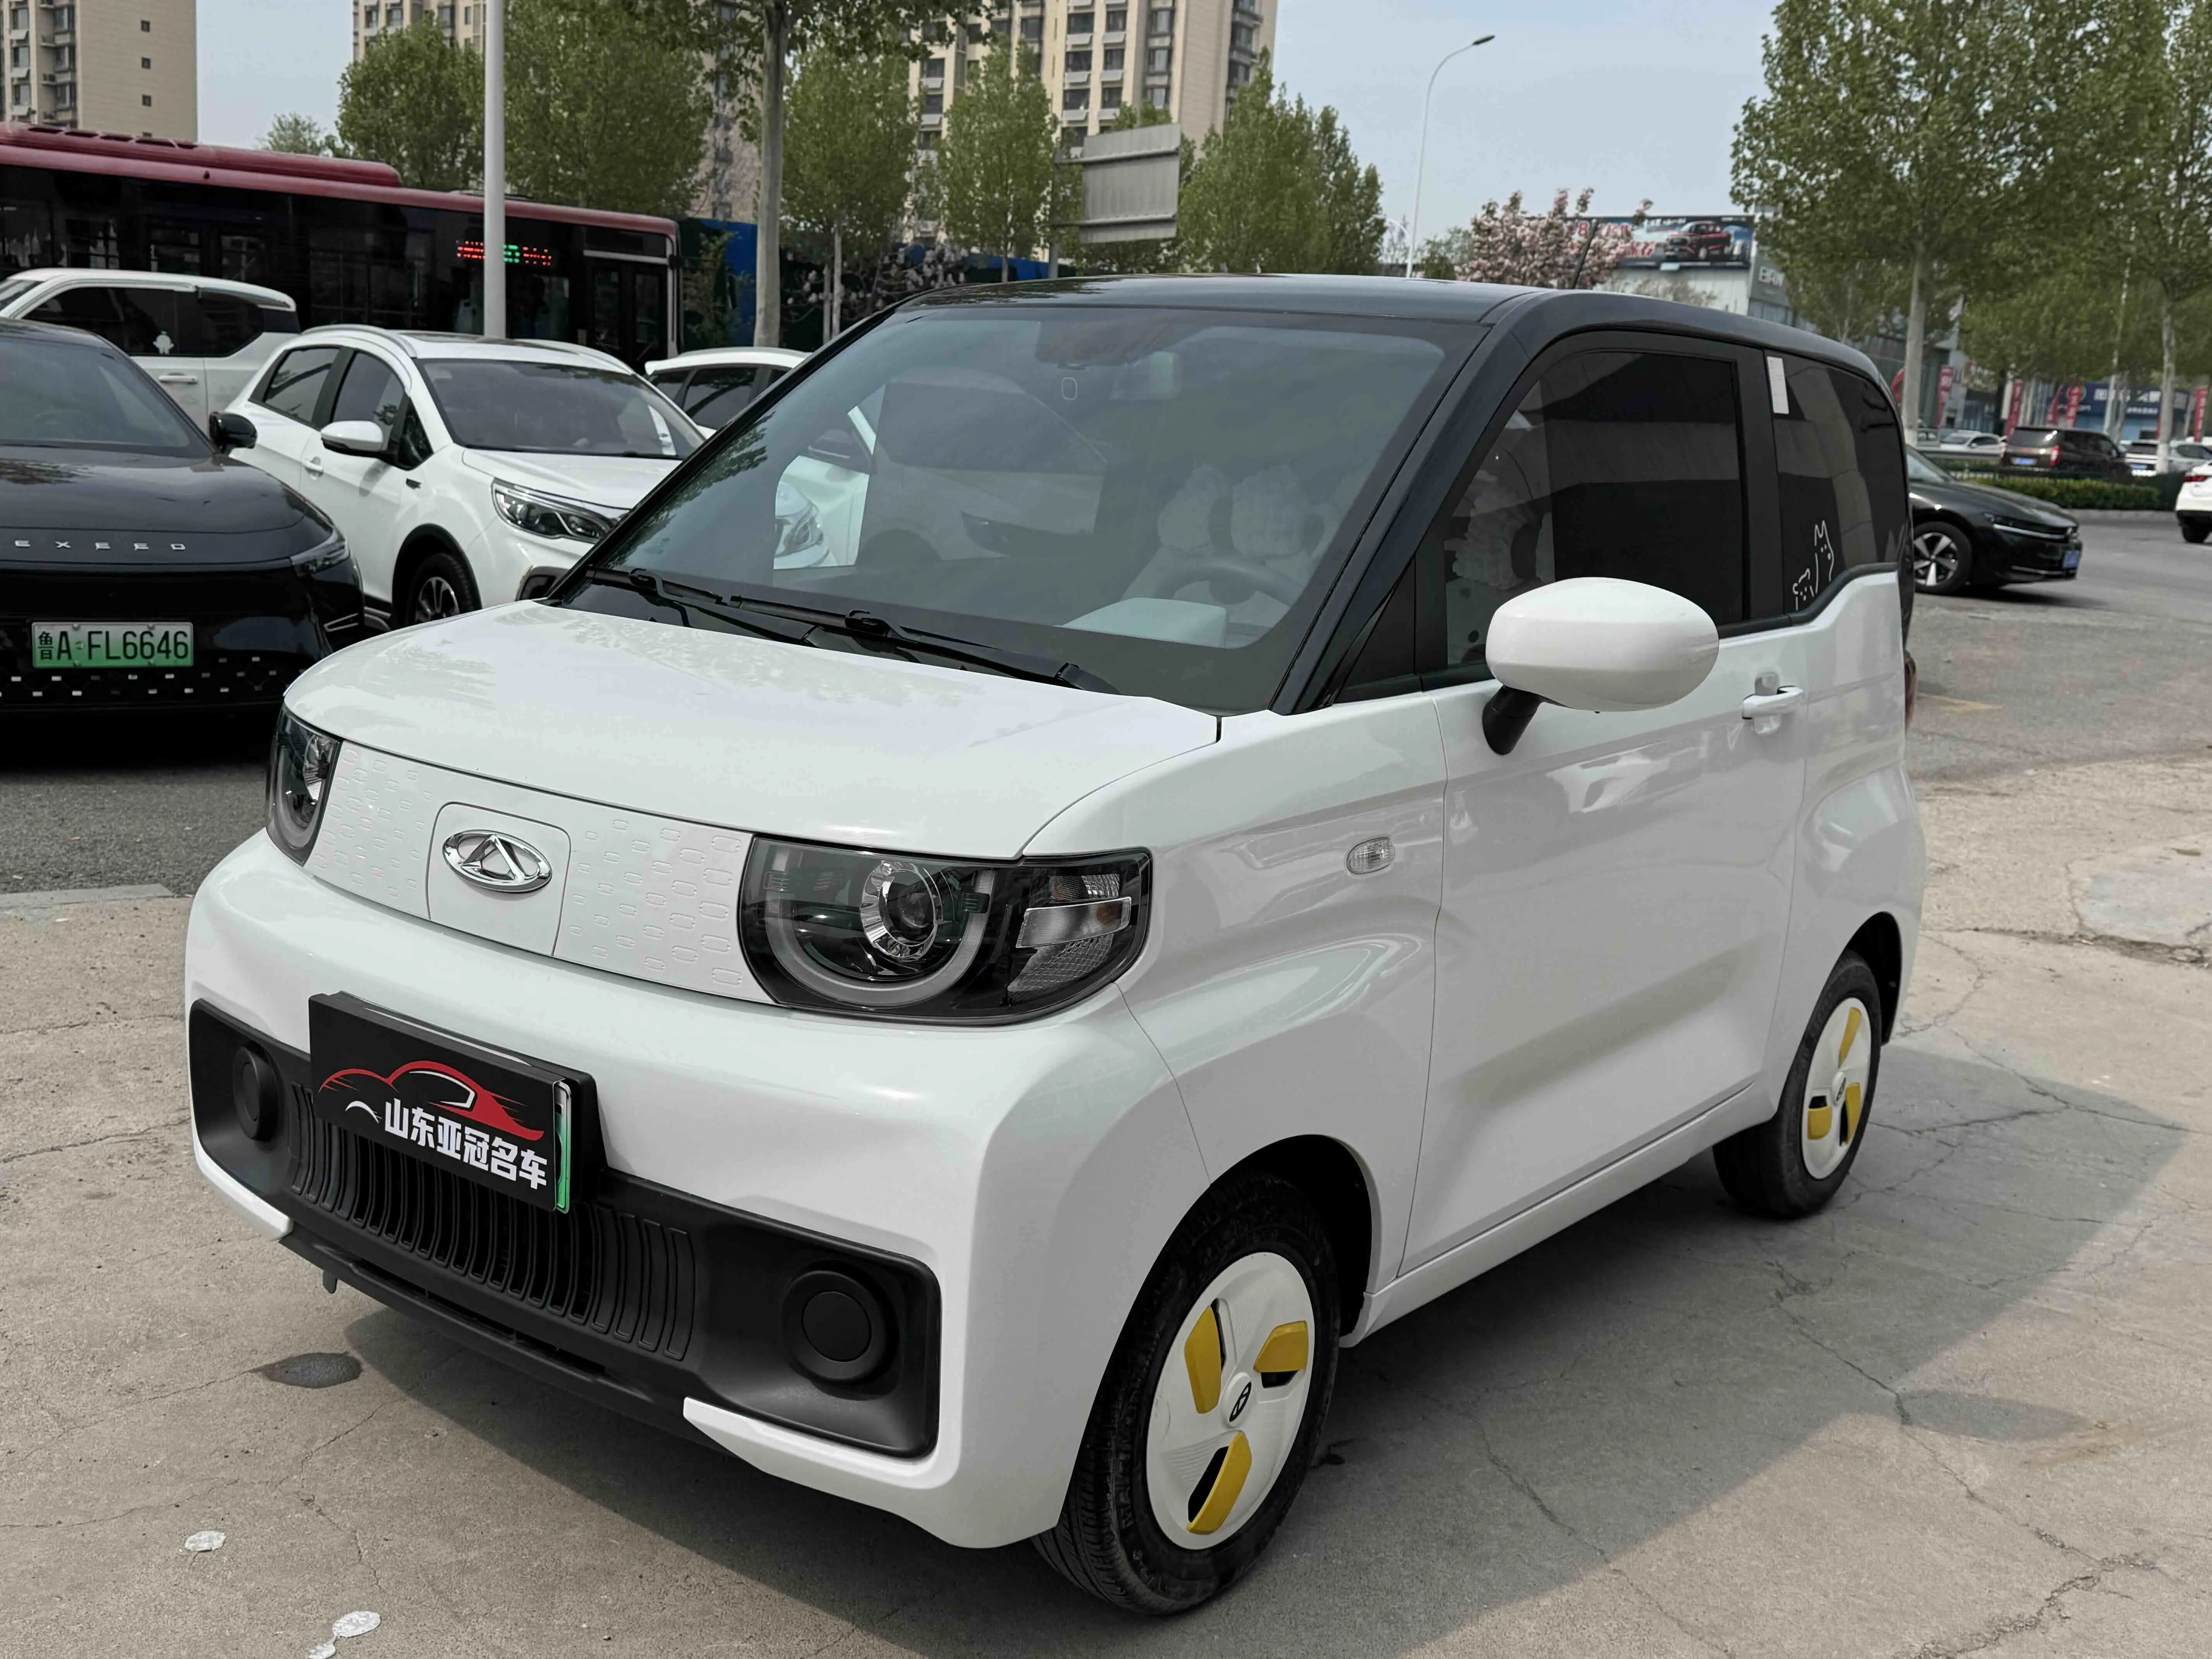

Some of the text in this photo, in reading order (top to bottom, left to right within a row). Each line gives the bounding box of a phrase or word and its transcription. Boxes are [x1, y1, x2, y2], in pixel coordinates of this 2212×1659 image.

[14, 539, 186, 551] EXEED
[385, 1097, 547, 1189] 山东亚冠名车
